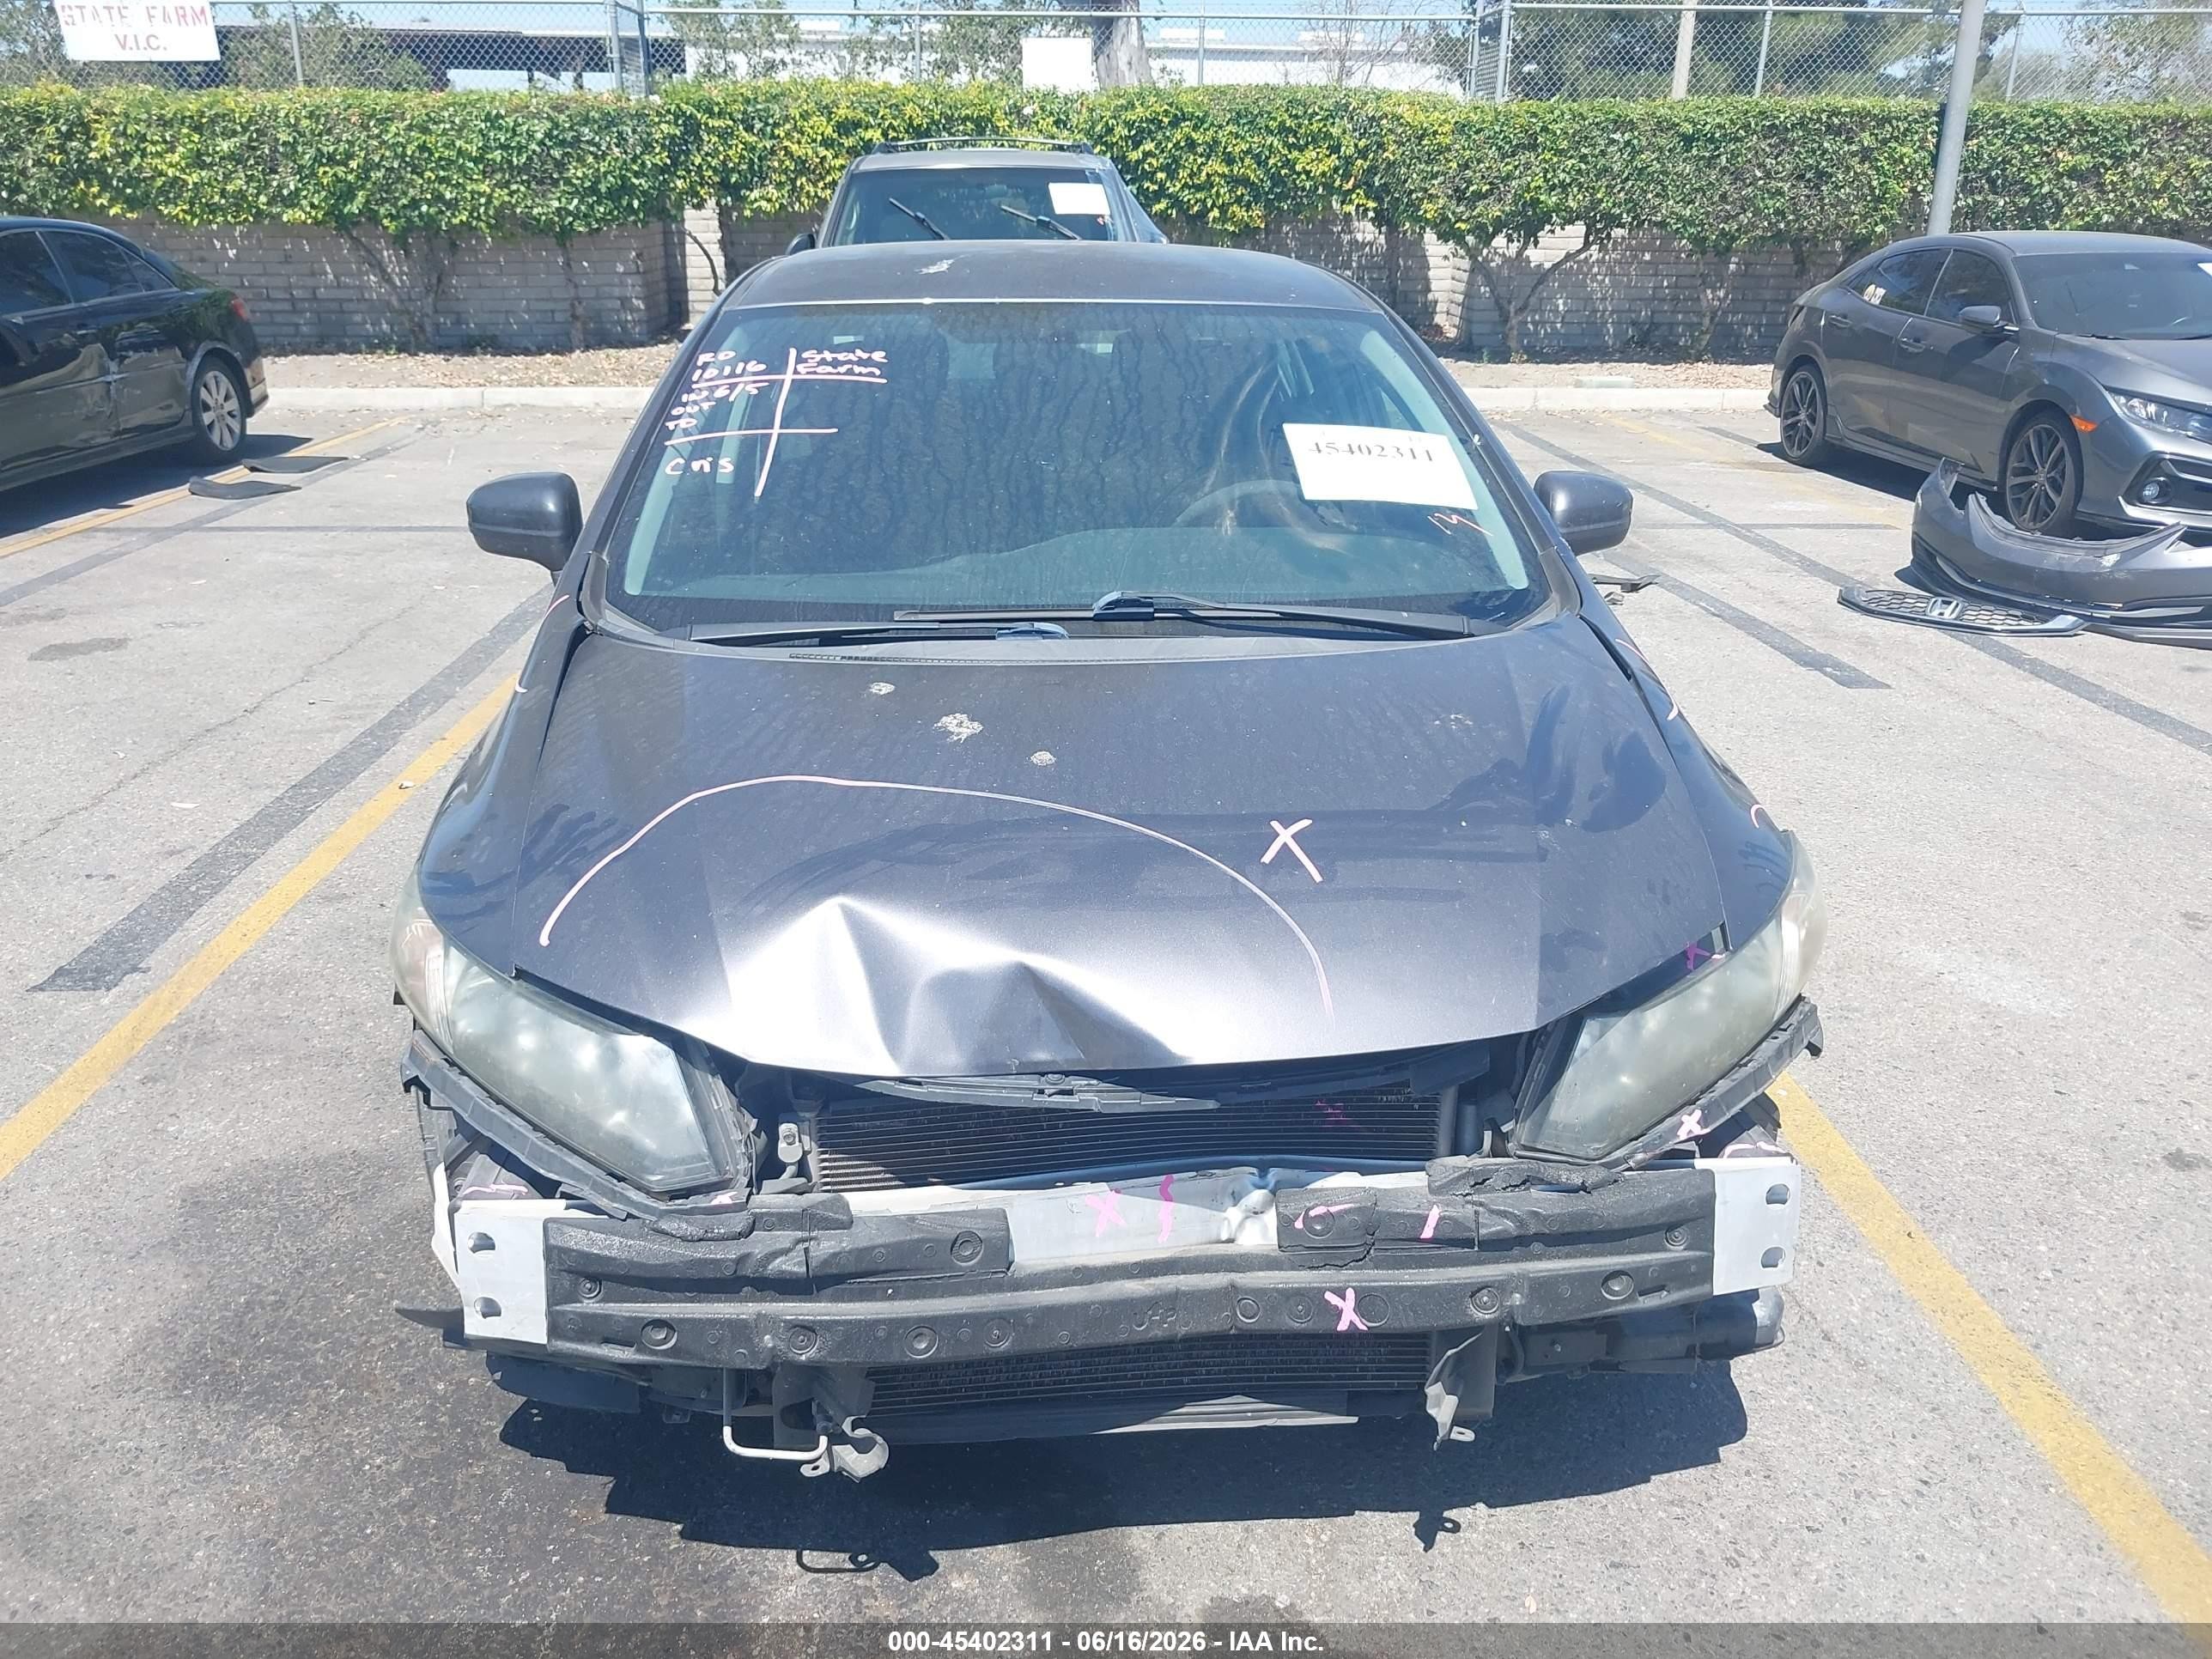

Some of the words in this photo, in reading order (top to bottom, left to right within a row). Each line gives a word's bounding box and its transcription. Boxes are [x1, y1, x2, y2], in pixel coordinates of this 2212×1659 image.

[61, 4, 131, 27] STATE
[146, 5, 209, 27] FARM
[114, 33, 167, 52] V.I.C.
[1309, 441, 1432, 461] 45402311
